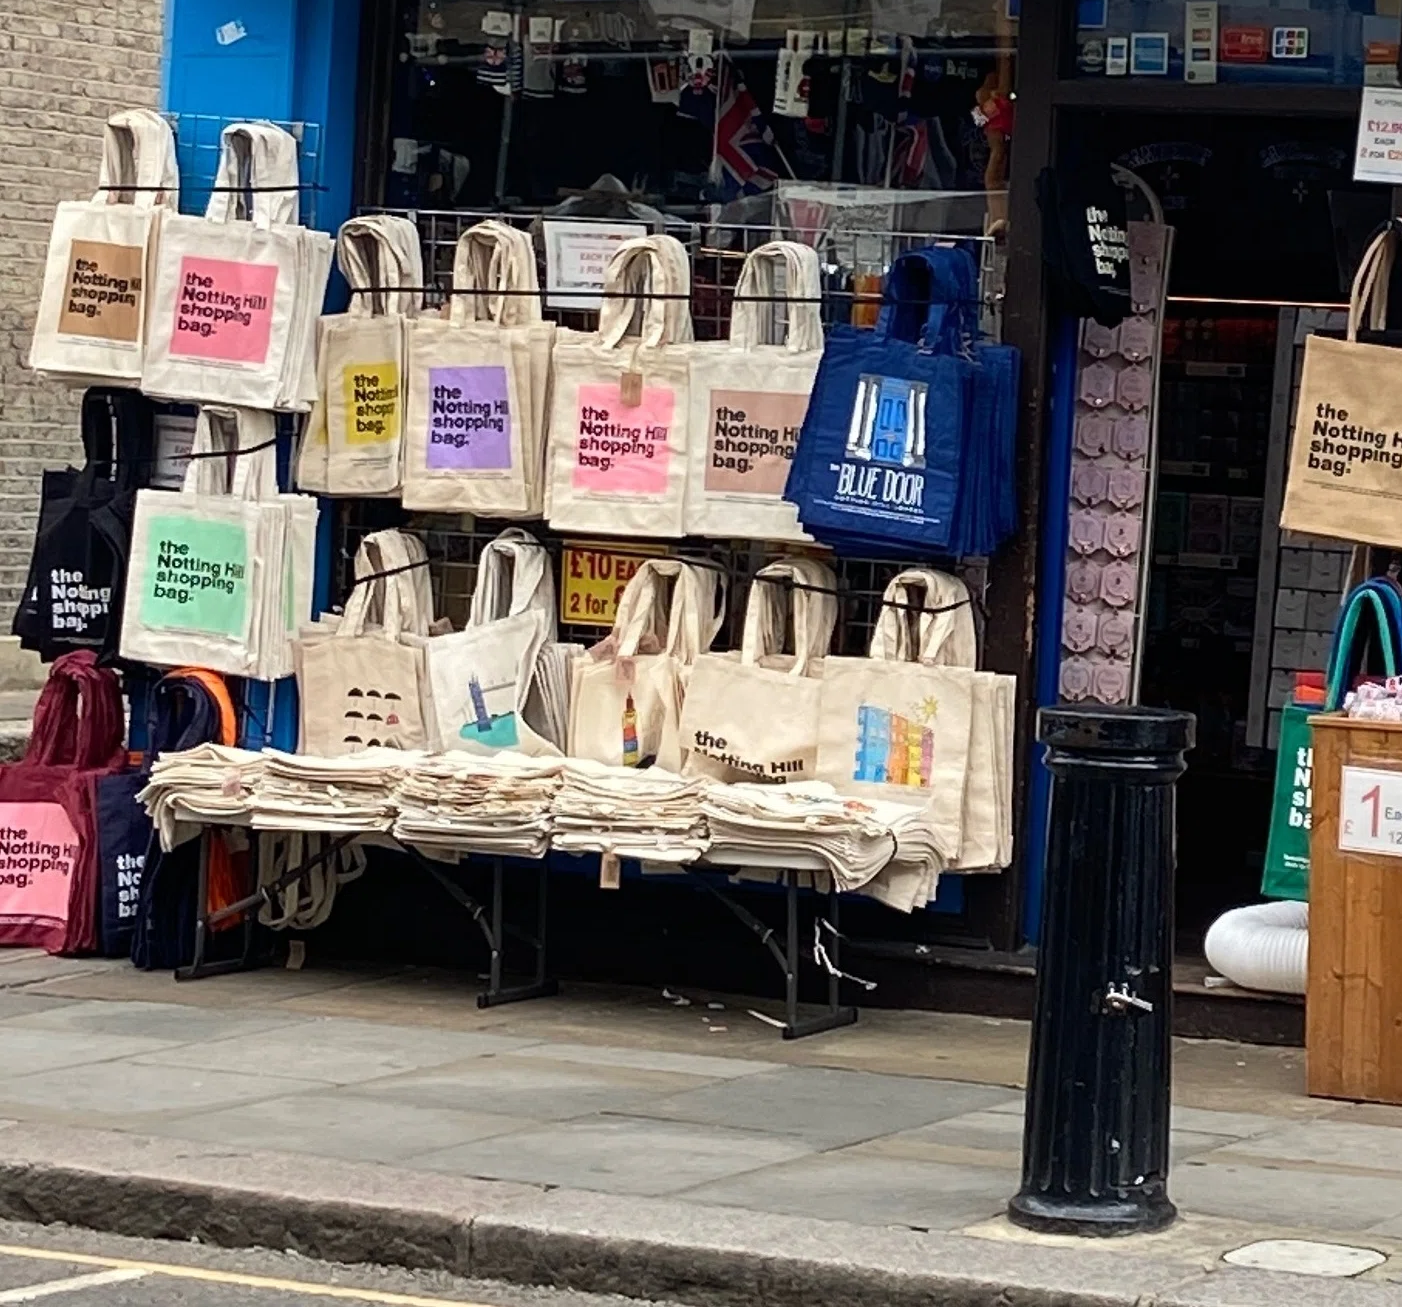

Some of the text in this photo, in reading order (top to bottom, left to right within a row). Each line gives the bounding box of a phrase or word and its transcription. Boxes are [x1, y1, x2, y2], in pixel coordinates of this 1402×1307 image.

[73, 272, 128, 292] Notting
[185, 271, 213, 288] the
[182, 286, 241, 311] Notting
[180, 301, 252, 327] shopping
[353, 374, 379, 387] the
[433, 385, 462, 400] the
[433, 400, 491, 417] Notting
[581, 406, 609, 421] the
[716, 407, 746, 422] the
[1316, 403, 1349, 421] the
[433, 416, 504, 433] shopping
[580, 421, 640, 442] Notting
[715, 421, 778, 443] Notting
[1313, 420, 1387, 448] Notting
[579, 438, 655, 458] shopping
[714, 438, 797, 460] shopping
[712, 453, 754, 473] bag.
[1308, 452, 1351, 477] bag.
[837, 463, 882, 500] BLUE
[882, 468, 924, 507] DOOR
[160, 540, 189, 555] the
[158, 555, 221, 579] Notting
[570, 551, 643, 581] £10 EA
[51, 569, 83, 584] the
[156, 571, 235, 594] shopping
[570, 592, 580, 613] 2
[585, 593, 609, 614] for
[695, 730, 727, 749] the
[771, 759, 803, 773] Hill
[0, 826, 27, 840] the
[0, 841, 60, 860] Notting
